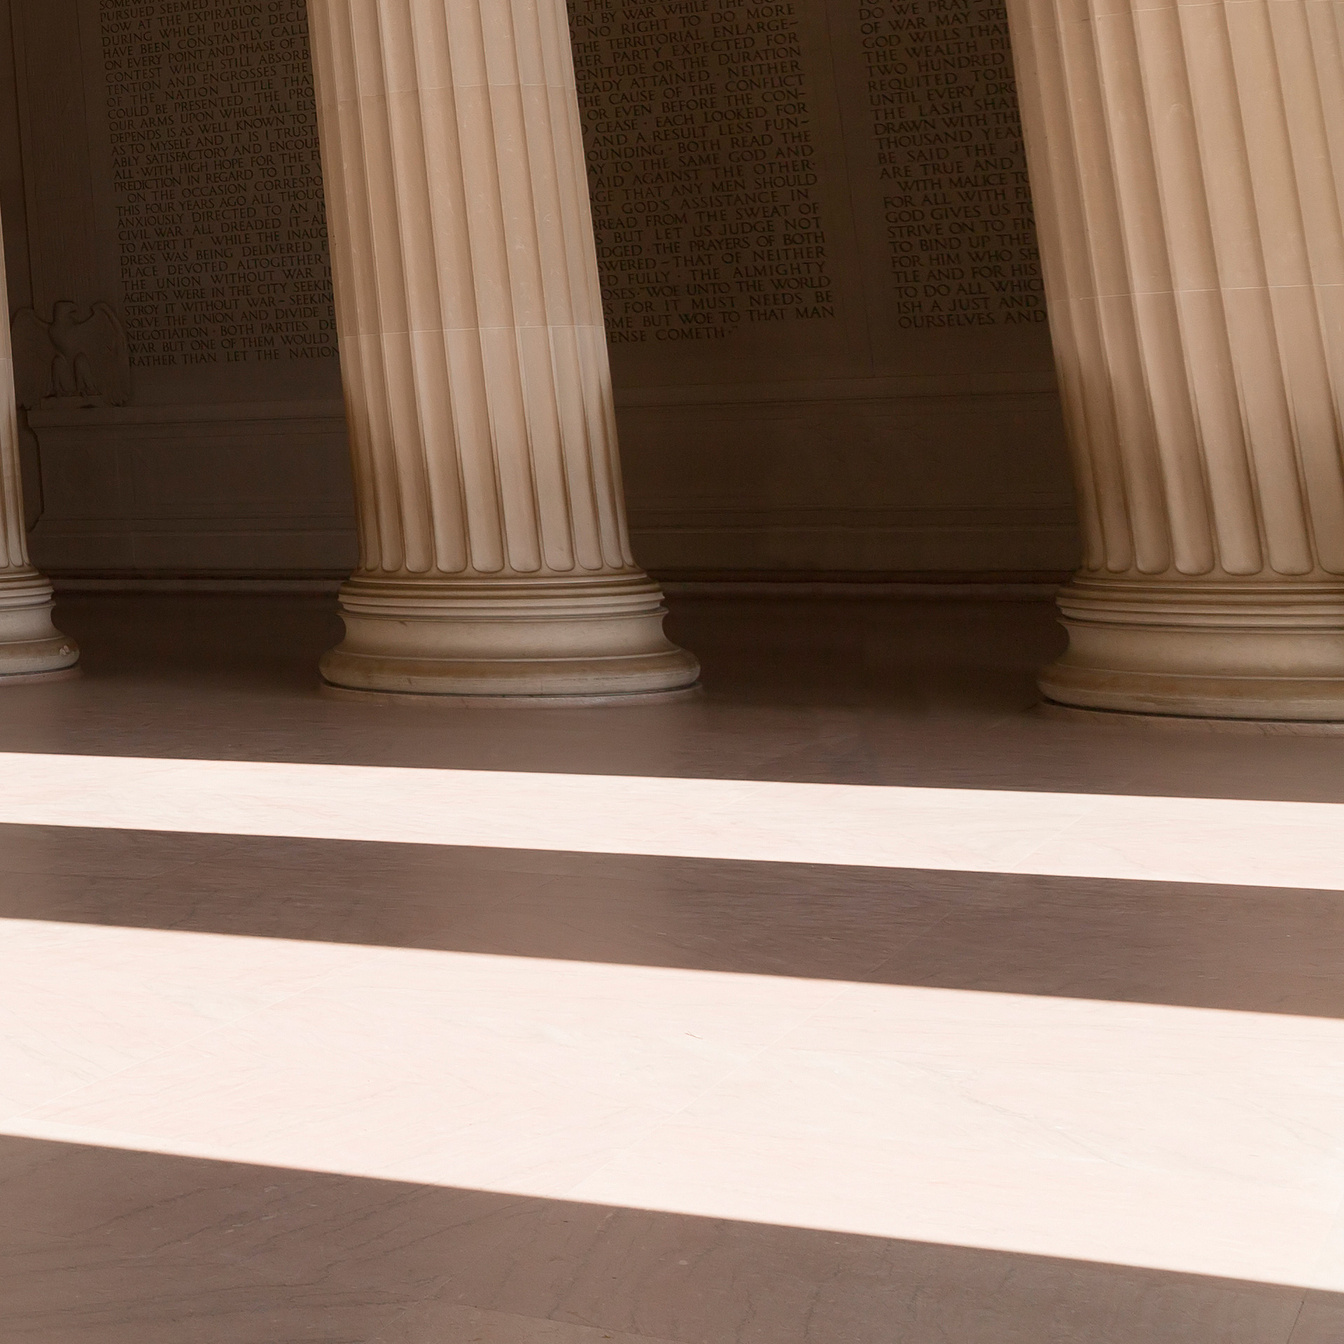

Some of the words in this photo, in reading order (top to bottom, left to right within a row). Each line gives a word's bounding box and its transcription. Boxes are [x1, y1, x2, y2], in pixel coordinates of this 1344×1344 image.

[100, 6, 154, 21] PURSUED
[860, 22, 880, 35] OF
[888, 17, 927, 30] WAR
[936, 11, 970, 26] MAY
[103, 46, 132, 58] HAVE
[140, 40, 170, 54] BEEN
[177, 29, 264, 49] CONSTANTLY
[612, 47, 661, 63] PARTY
[672, 36, 755, 56] EXPECTED
[766, 32, 799, 46] FOR
[652, 60, 675, 72] OR
[679, 56, 708, 69] THE
[718, 46, 801, 65] DURATION
[865, 62, 908, 77] TWO
[917, 53, 1005, 72] HUNDRED
[105, 80, 161, 94] TENTION
[167, 75, 196, 88] AND
[203, 66, 276, 84] ENGROSSES
[282, 62, 309, 74] THE
[608, 90, 655, 104] CAUSE
[663, 86, 681, 99] OF
[688, 83, 717, 96] THE
[725, 73, 805, 92] CONFLICT
[109, 119, 135, 131] OUR
[140, 115, 174, 128] ARMS
[180, 111, 214, 123] UPON
[219, 105, 262, 118] WHICH
[269, 103, 290, 114] ALL
[870, 106, 905, 120] THE
[918, 101, 963, 116] LASH
[875, 130, 972, 149] THOUSAND
[112, 156, 139, 167] ABLY
[145, 146, 228, 164] SATISFACTORY
[233, 143, 262, 156] AND
[612, 161, 633, 172] TO
[642, 158, 668, 170] THE
[678, 153, 719, 167] SAME
[728, 149, 766, 162] GOD
[775, 145, 814, 158] AND
[622, 182, 703, 199] ANY
[711, 179, 745, 192] MEN
[754, 173, 817, 189] SHOULD
[115, 205, 140, 216] THIS
[145, 202, 175, 214] FOUR
[178, 198, 214, 210] YEARS
[219, 195, 246, 208] AGO
[251, 193, 274, 205] ALL
[883, 195, 916, 209] FOR
[921, 193, 951, 206] ALL
[957, 189, 1006, 202] WITH
[614, 230, 643, 243] BUT
[655, 227, 682, 240] LET
[692, 225, 712, 237] US
[718, 220, 775, 235] JUDGE
[784, 217, 821, 230] NOT
[120, 253, 155, 266] DRESS
[162, 251, 188, 262] WAS
[196, 247, 233, 260] BEING
[242, 242, 312, 257] DELIVERED
[888, 241, 913, 253] TO
[919, 237, 961, 251] BIND
[968, 235, 990, 248] UP
[995, 232, 1031, 246] THE
[121, 279, 146, 290] THE
[156, 276, 201, 288] UNION
[210, 270, 274, 284] WITHOUT
[282, 268, 313, 279] WAR
[893, 286, 918, 298] TO
[923, 284, 951, 297] DO
[956, 282, 986, 295] ALL
[624, 301, 655, 313] FOR
[665, 299, 680, 311] IT
[691, 296, 736, 309] MUST
[749, 293, 803, 306] NEEDS
[815, 291, 832, 303] BE
[125, 317, 158, 328] SOLVE
[164, 315, 186, 326] THE
[193, 312, 234, 324] UNION
[241, 310, 268, 321] AND
[275, 307, 318, 319] DIVIDE
[898, 312, 996, 329] OURSELVES
[128, 355, 177, 367] RATHER
[181, 352, 217, 364] THAN
[226, 350, 248, 362] LET
[255, 349, 279, 361] THE
